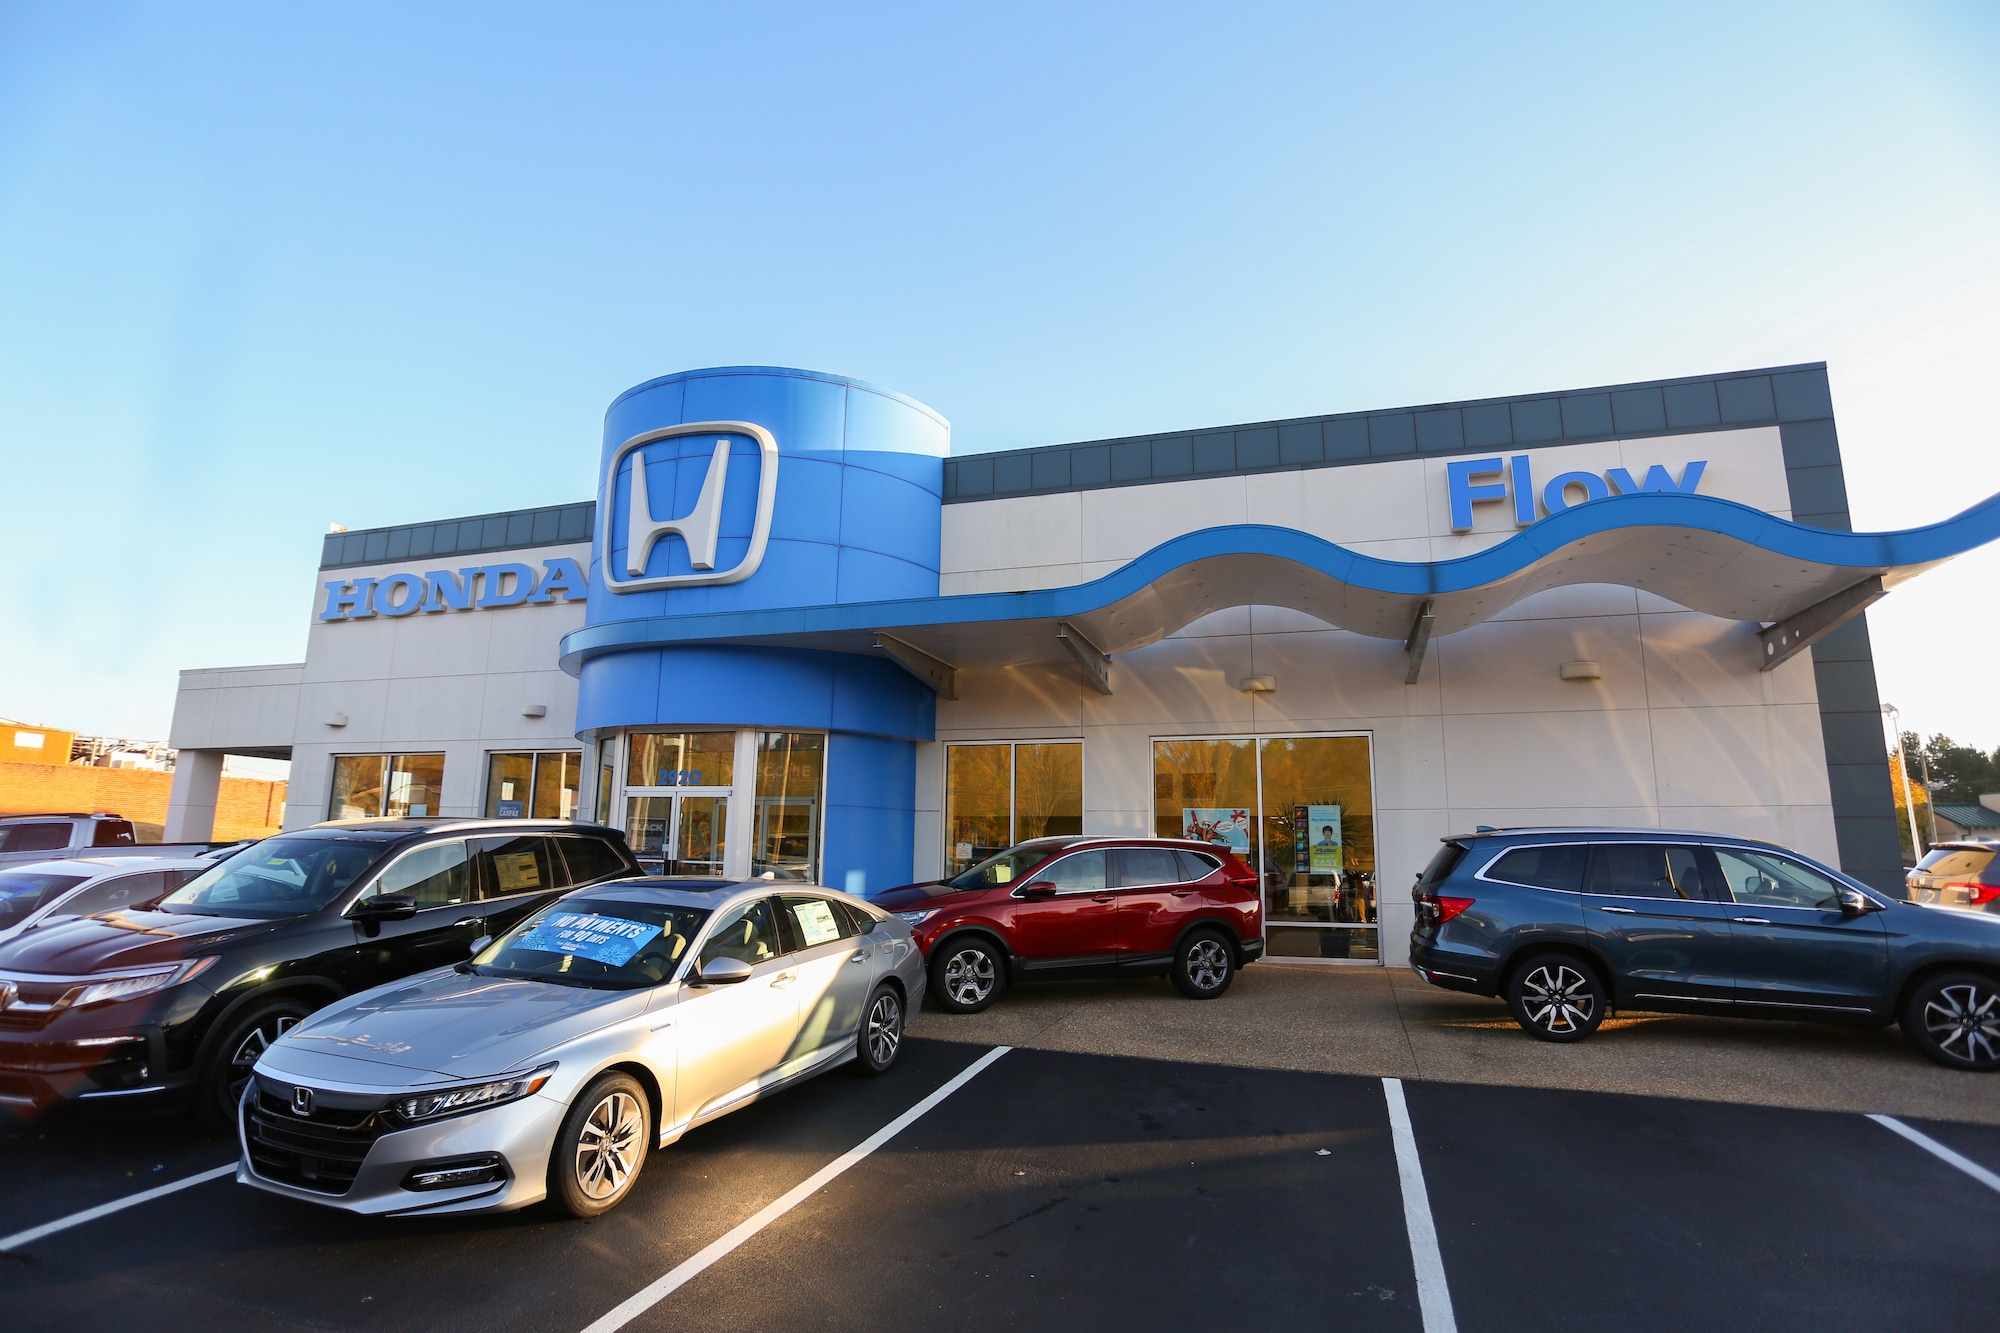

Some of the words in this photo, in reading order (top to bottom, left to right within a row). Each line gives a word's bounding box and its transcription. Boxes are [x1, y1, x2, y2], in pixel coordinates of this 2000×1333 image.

[1446, 455, 1708, 533] Flow
[318, 557, 588, 622] HONDA
[657, 769, 702, 785] 2920
[630, 823, 663, 832] BLACK
[1314, 859, 1339, 867] EASY
[550, 915, 579, 928] NO
[569, 916, 647, 939] PAYMENTS
[555, 929, 576, 939] FOR
[569, 930, 593, 942] 90
[585, 934, 611, 945] DAYS
